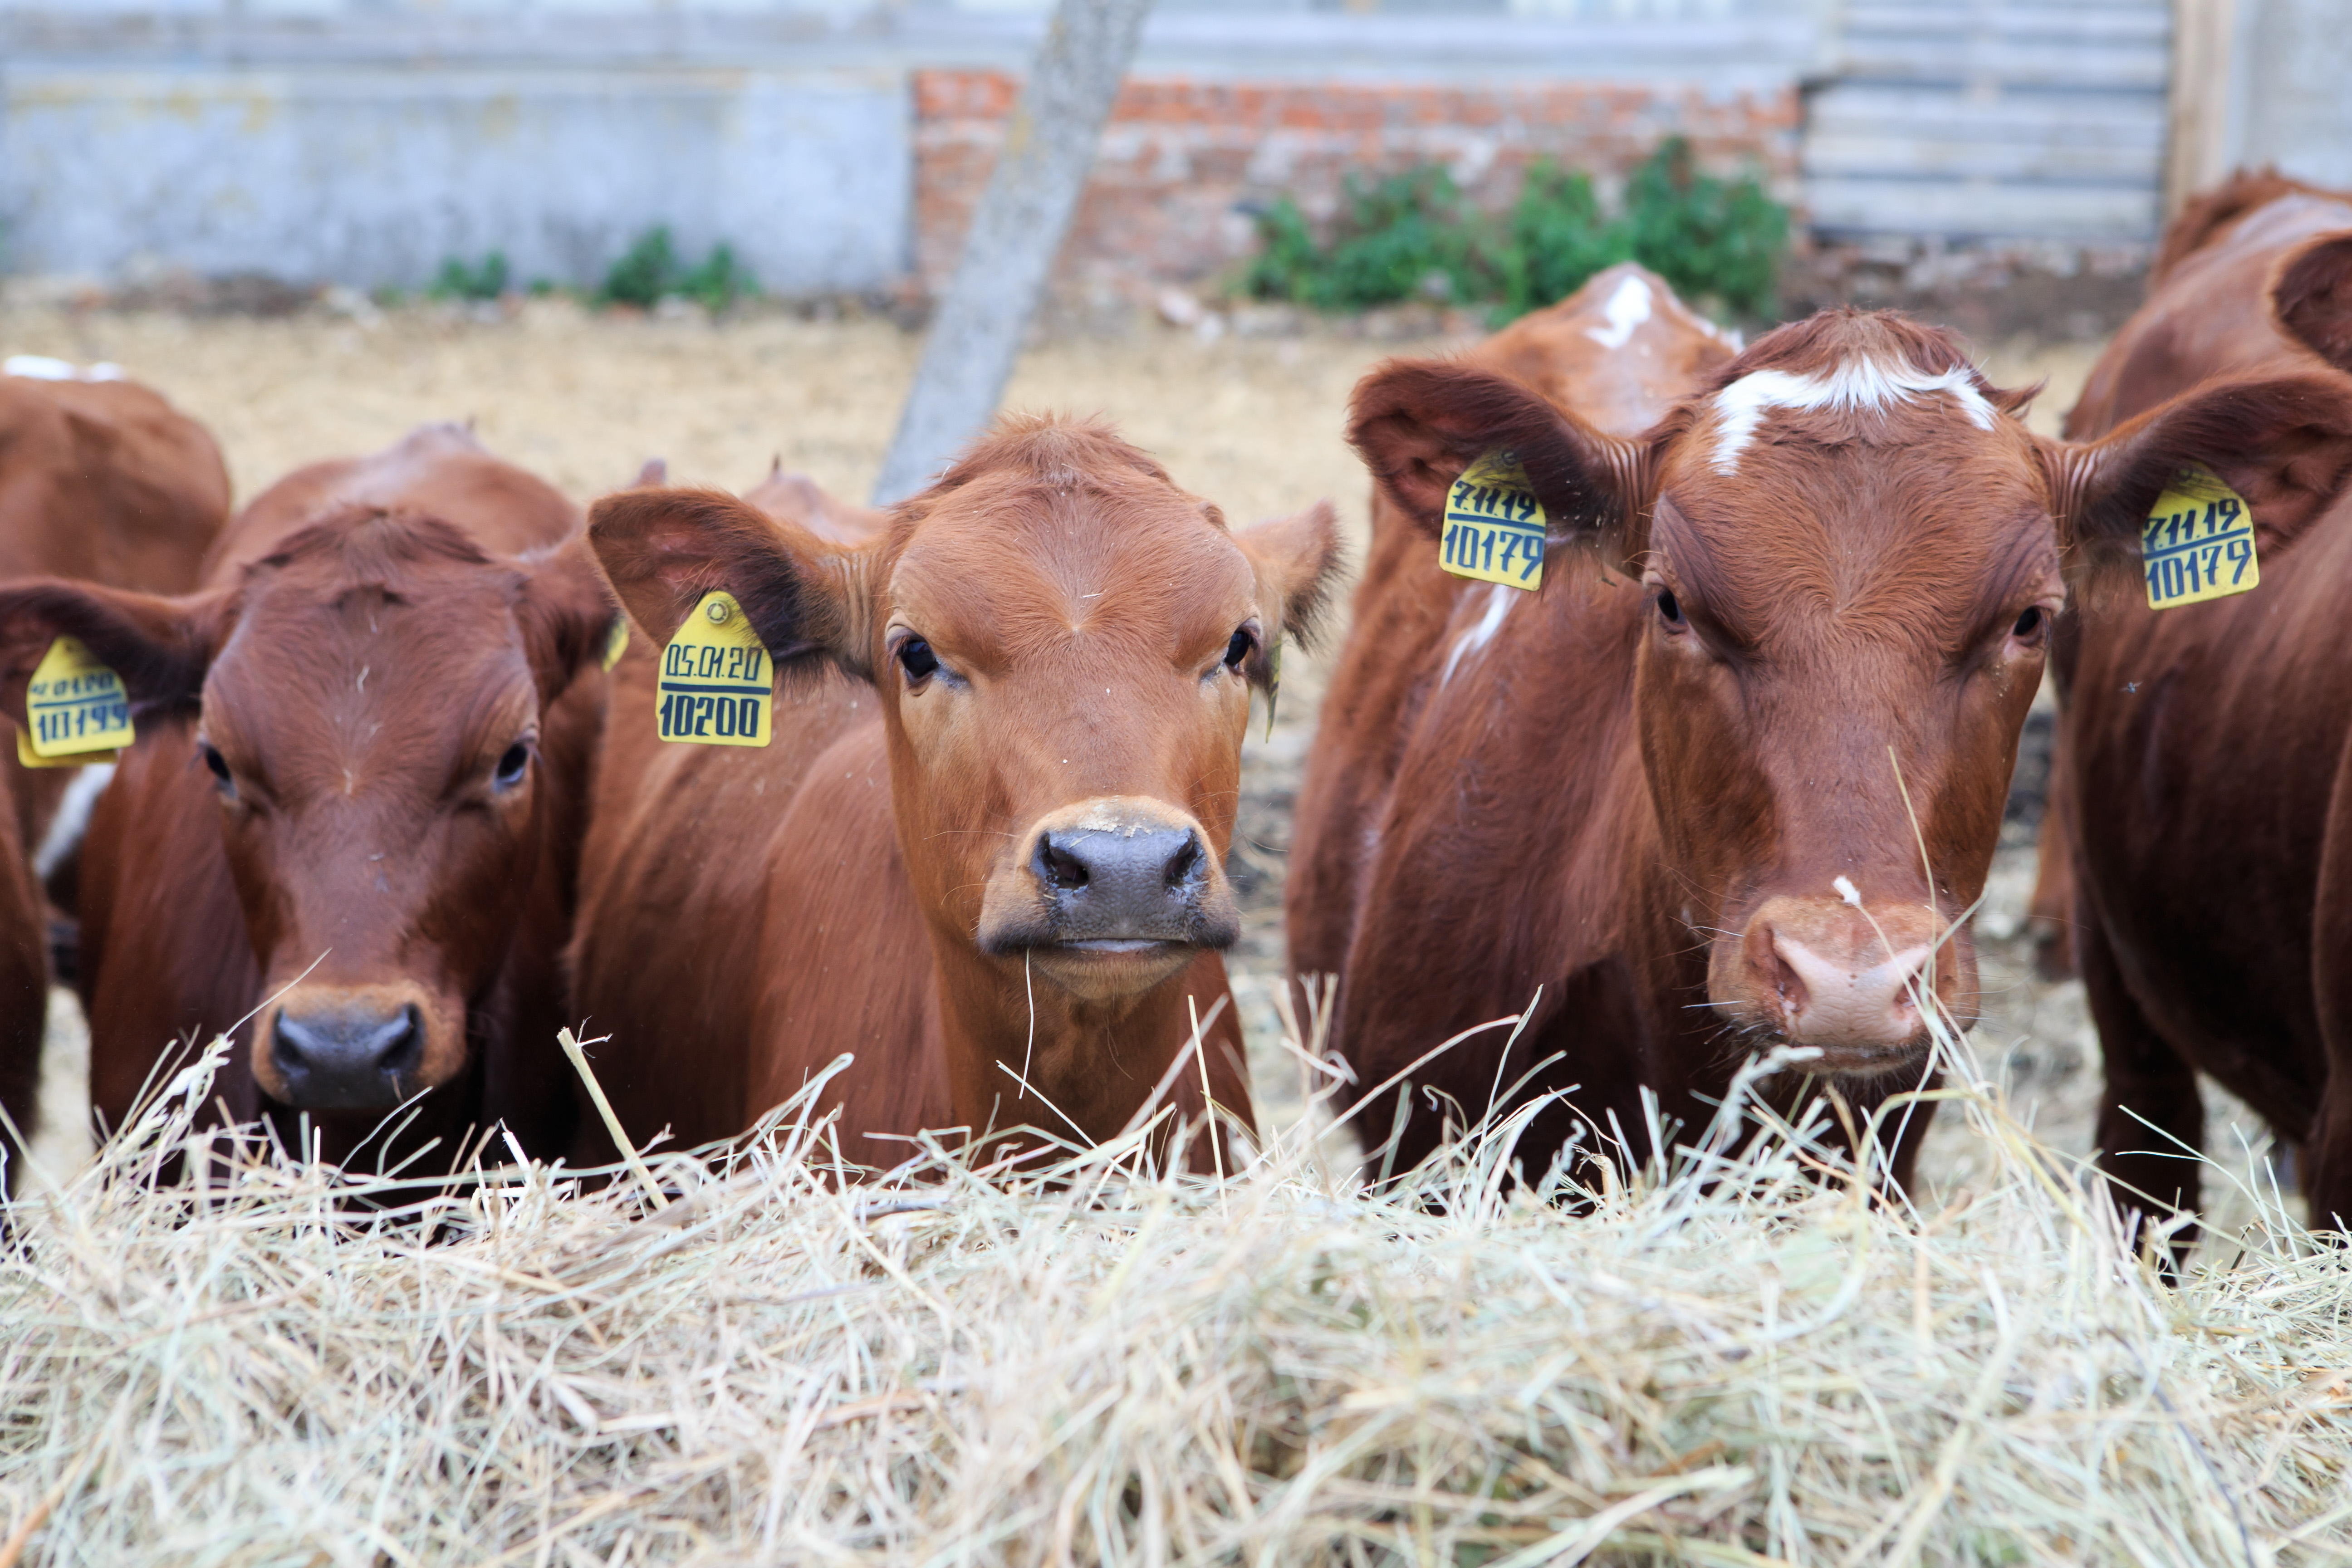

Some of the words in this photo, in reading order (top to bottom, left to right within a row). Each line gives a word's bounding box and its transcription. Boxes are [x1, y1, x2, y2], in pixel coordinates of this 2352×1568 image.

[1453, 480, 1536, 522] 7.11.19
[2143, 499, 2241, 552] 7.11.19
[1445, 524, 1544, 580] 10179
[2146, 539, 2252, 601] 10179
[666, 644, 762, 681] 05.01.20
[660, 695, 760, 737] 10200
